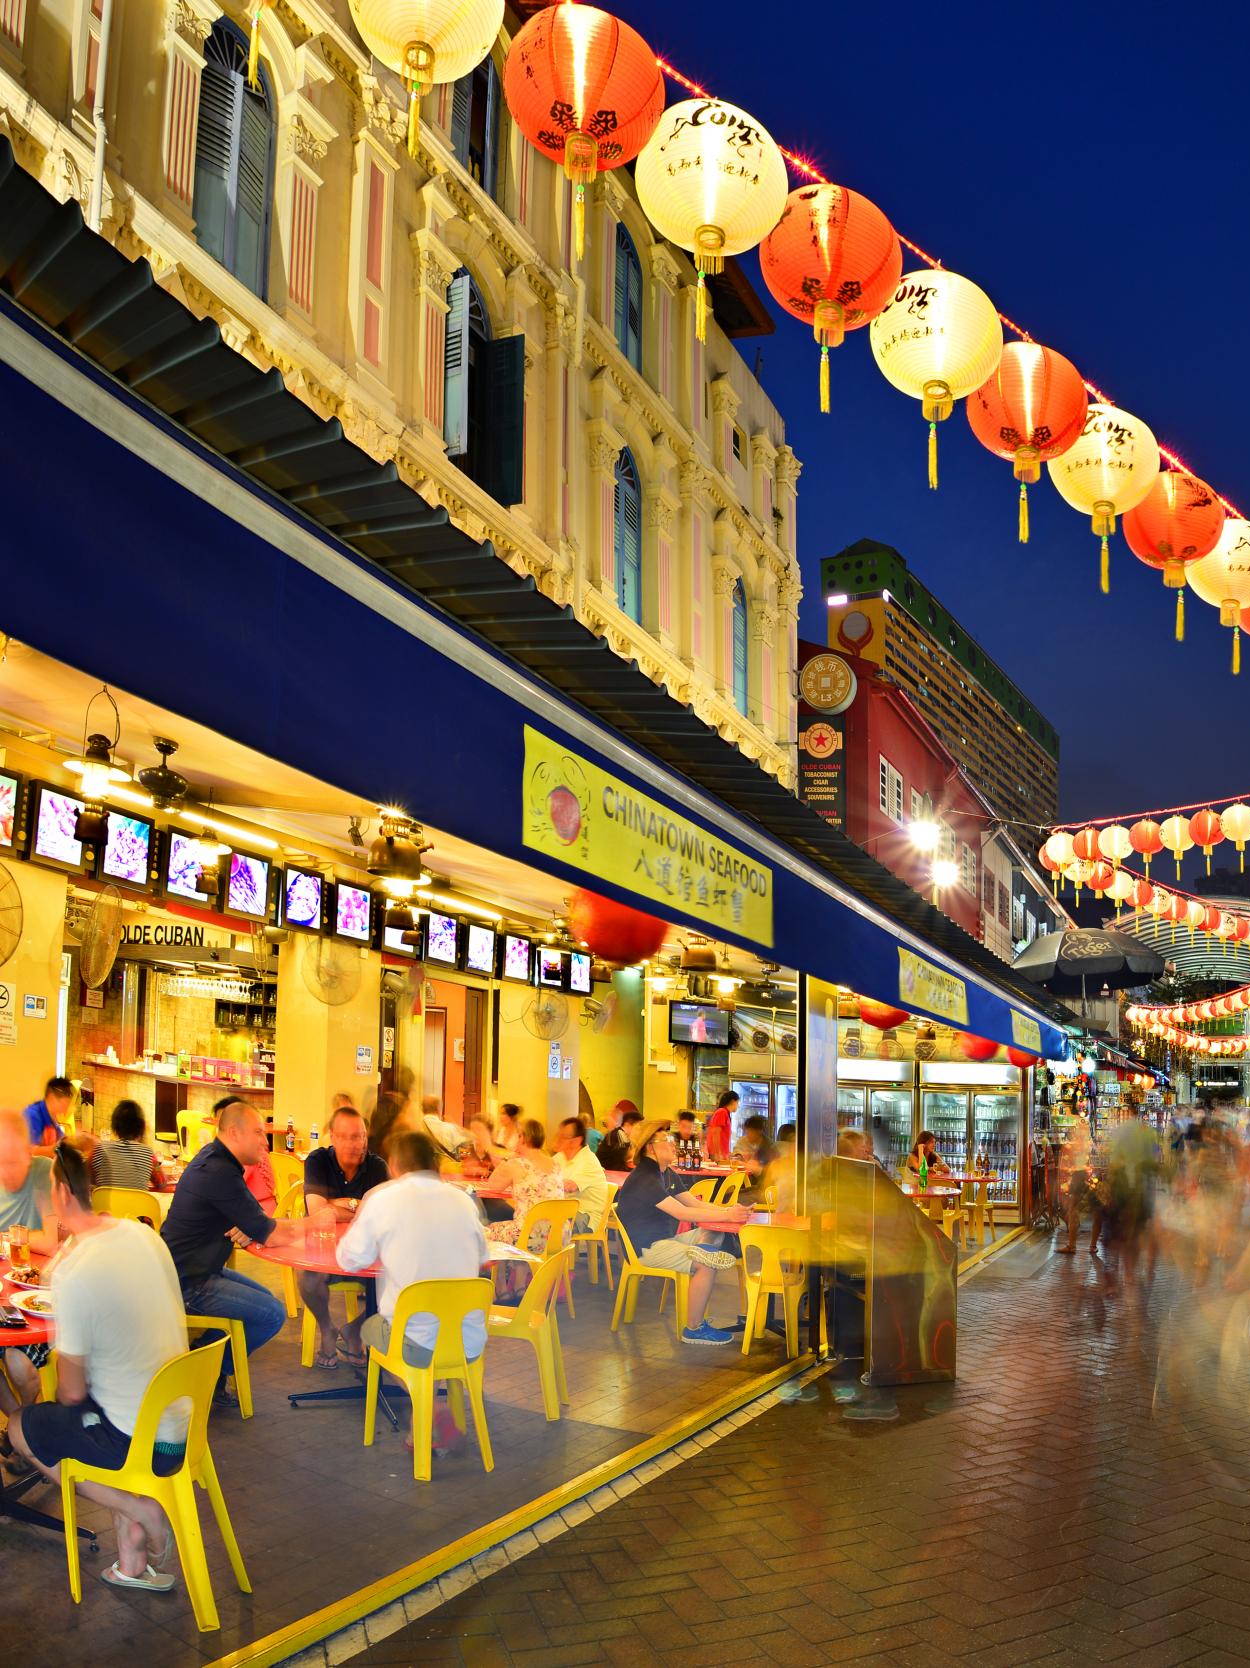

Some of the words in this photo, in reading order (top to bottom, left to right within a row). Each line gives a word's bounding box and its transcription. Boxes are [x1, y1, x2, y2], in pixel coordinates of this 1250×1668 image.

[602, 785, 705, 867] CHINATOWN
[709, 845, 768, 899] SEAFOOD
[119, 924, 152, 945] OLDE
[154, 924, 205, 947] CUBAN
[1066, 939, 1115, 959] Tiger
